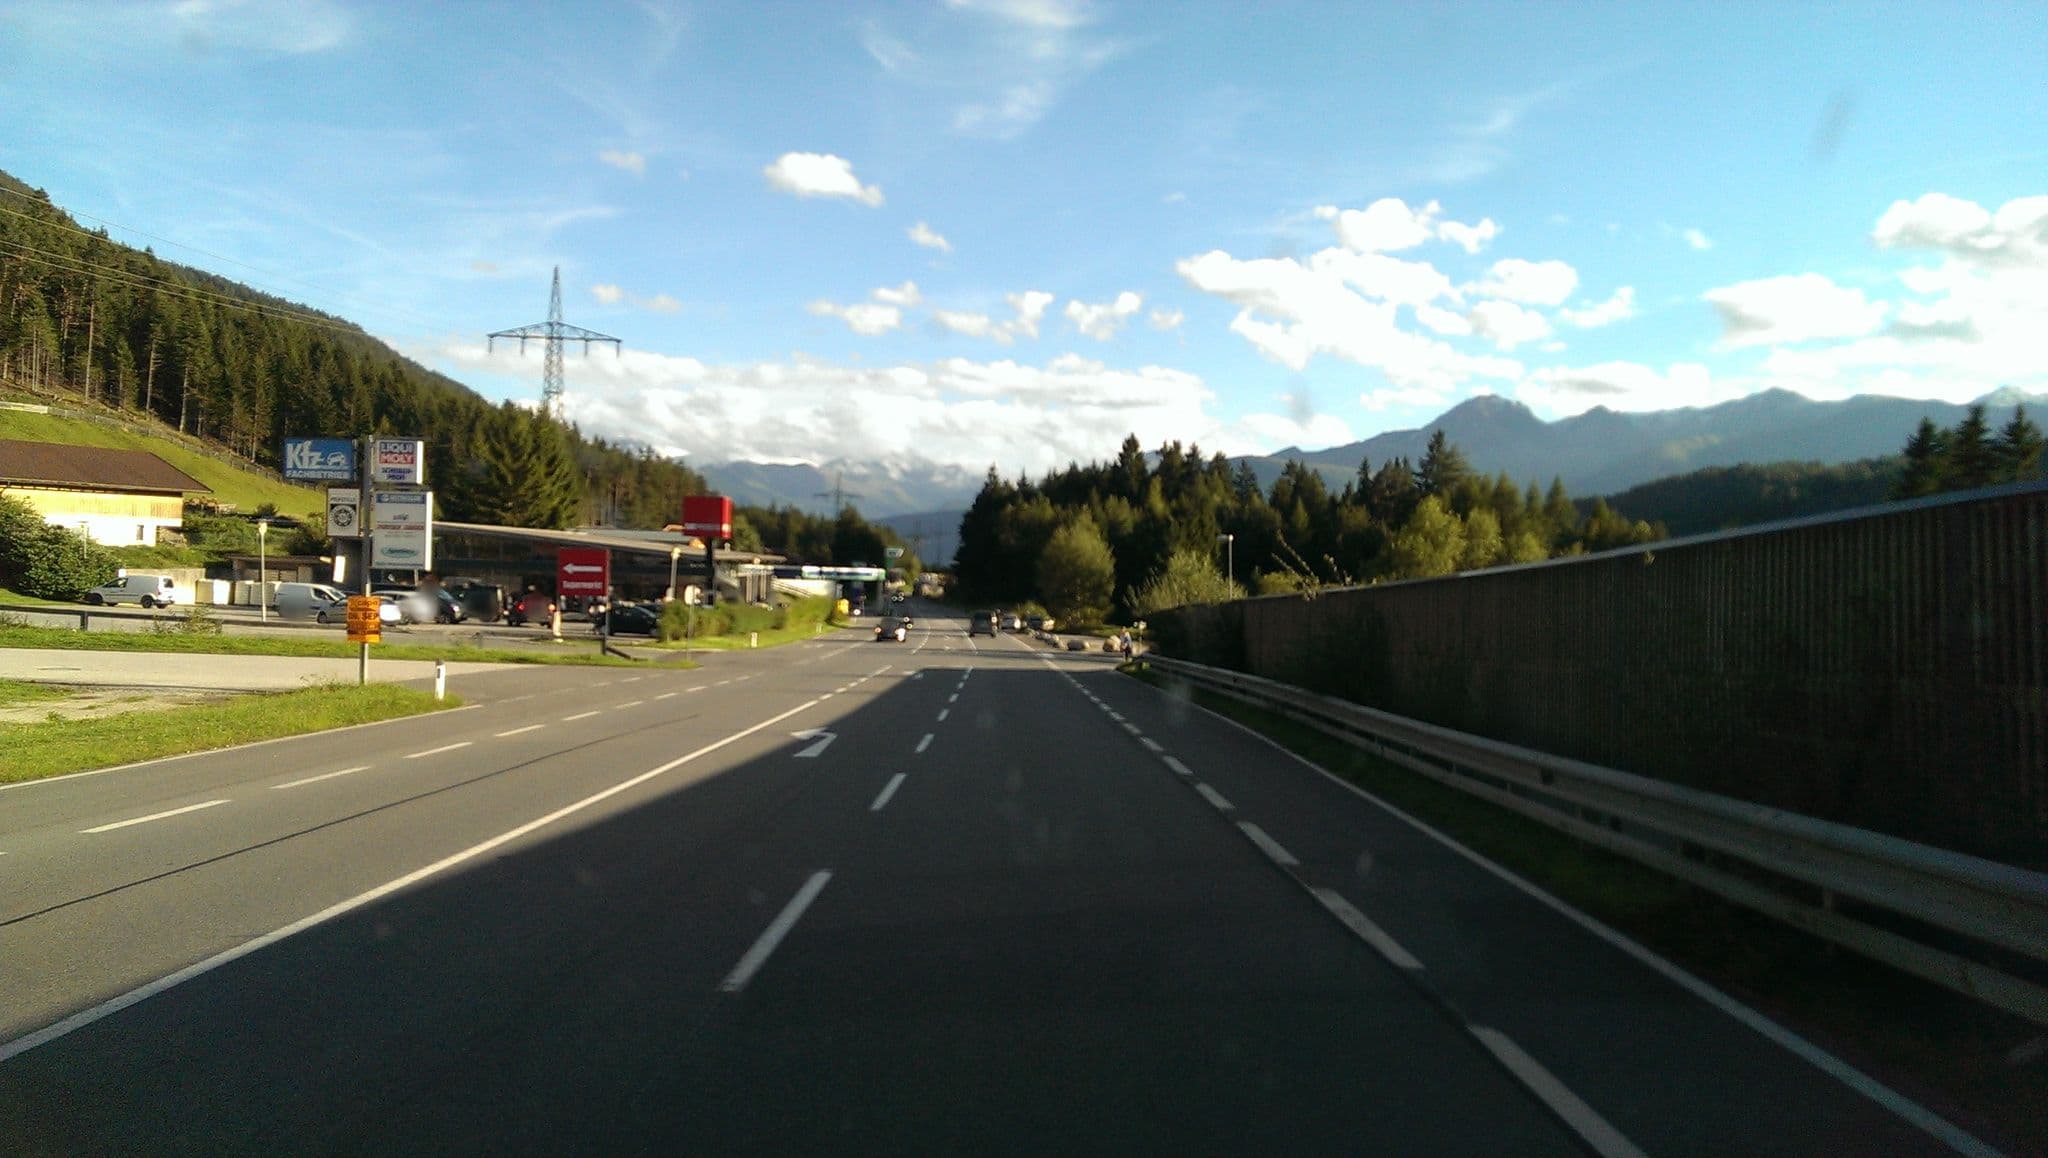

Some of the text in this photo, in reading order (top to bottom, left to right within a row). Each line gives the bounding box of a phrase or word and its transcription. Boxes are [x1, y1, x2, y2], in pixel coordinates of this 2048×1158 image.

[380, 442, 413, 453] LIQUI
[286, 440, 325, 469] Kfz
[380, 453, 413, 464] MOLY
